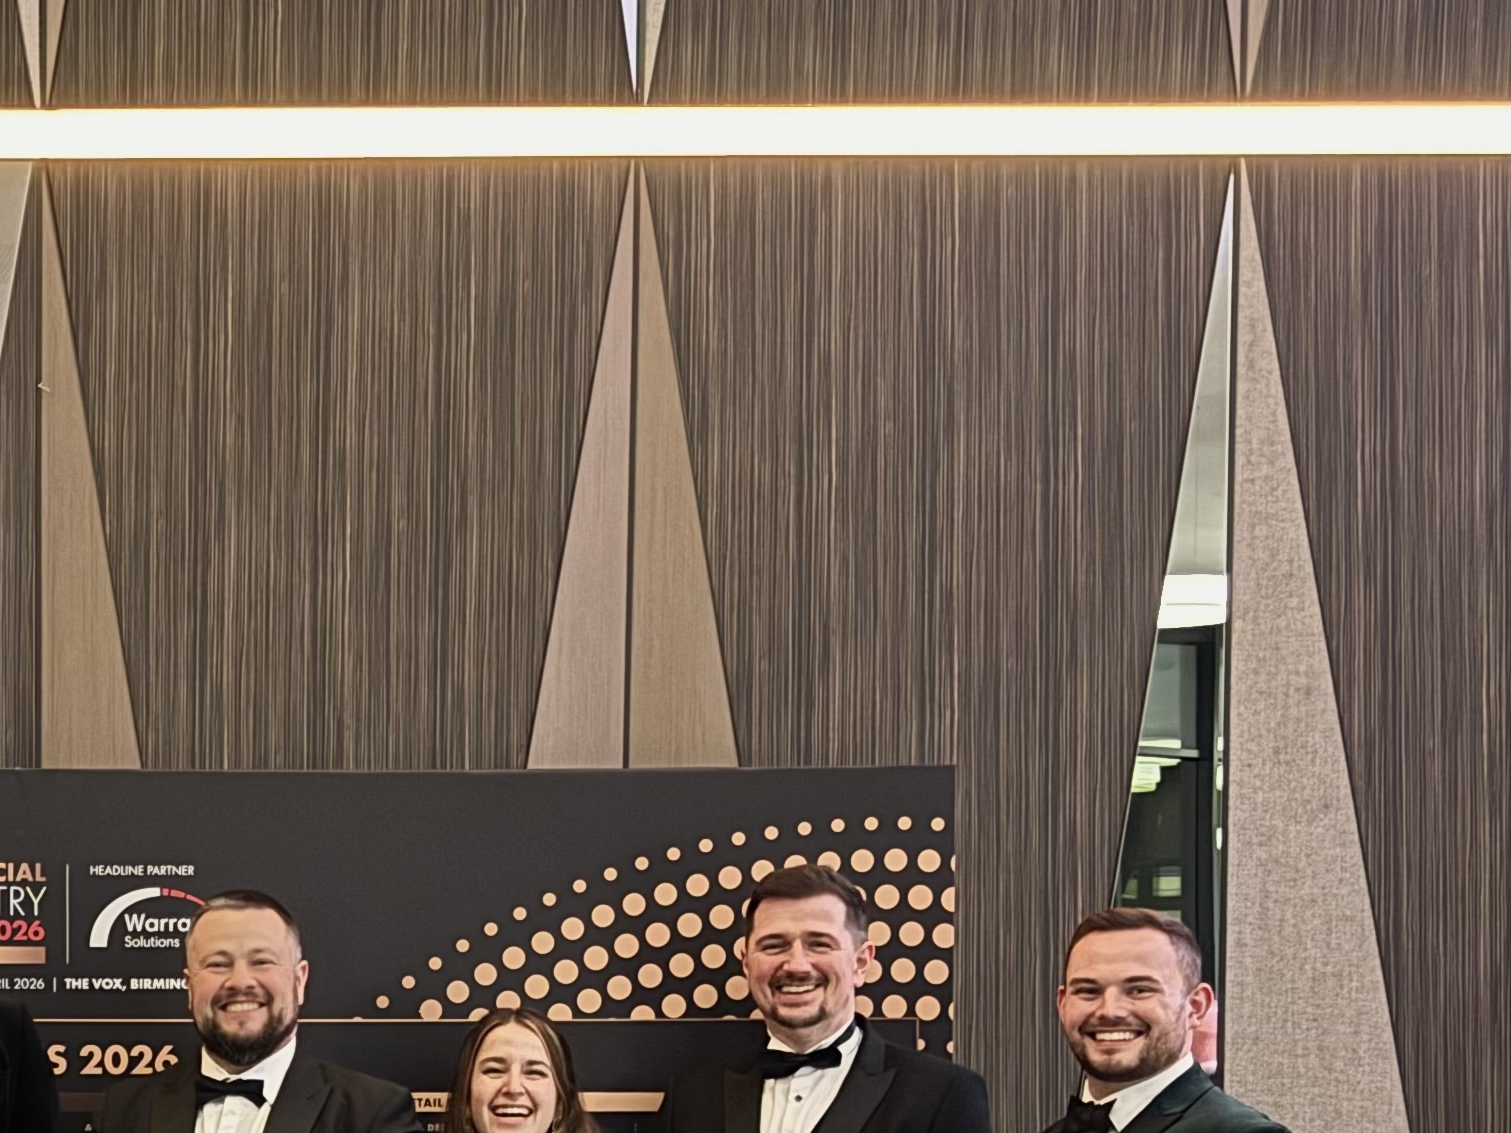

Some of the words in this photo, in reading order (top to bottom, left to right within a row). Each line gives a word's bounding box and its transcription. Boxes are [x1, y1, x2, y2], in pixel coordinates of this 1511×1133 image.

[90, 865, 144, 876] HEADLINE
[147, 865, 195, 876] PARTNER
[124, 936, 180, 948] Solutions
[13, 978, 45, 990] 2026
[64, 978, 89, 990] THE
[91, 978, 127, 991] VOX,
[79, 1044, 178, 1075] 2026
